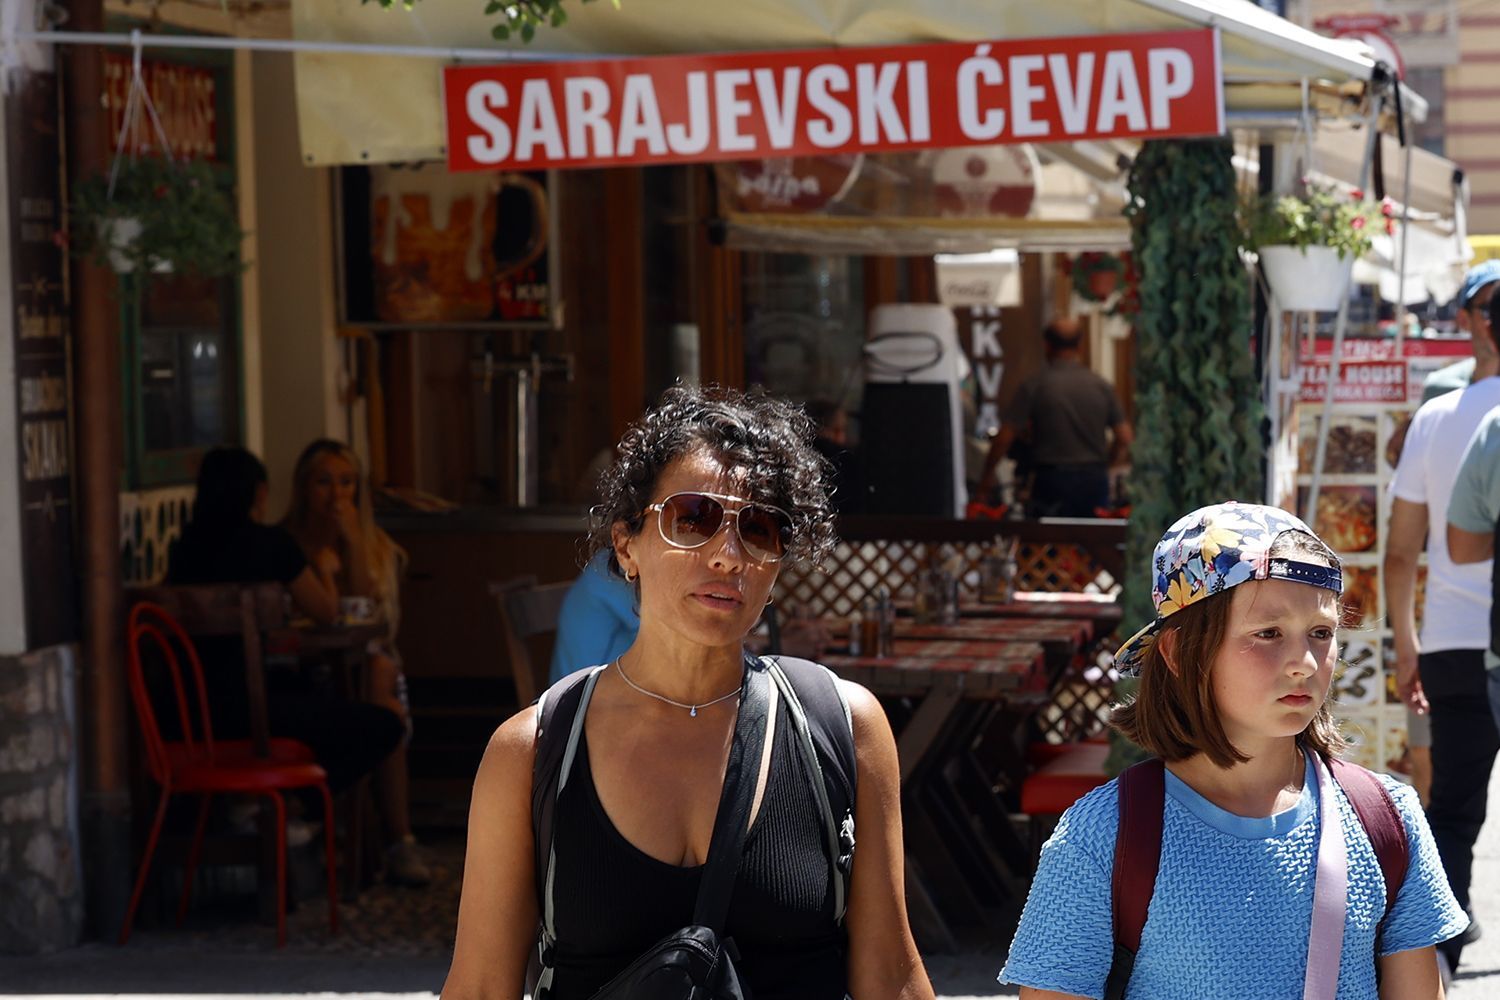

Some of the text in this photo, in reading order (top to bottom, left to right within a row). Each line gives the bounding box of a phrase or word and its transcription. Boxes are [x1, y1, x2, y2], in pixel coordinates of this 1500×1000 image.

[465, 45, 1194, 164] SARAJEVSKI ĆEVAP
[1346, 366, 1403, 384] HOUSE
